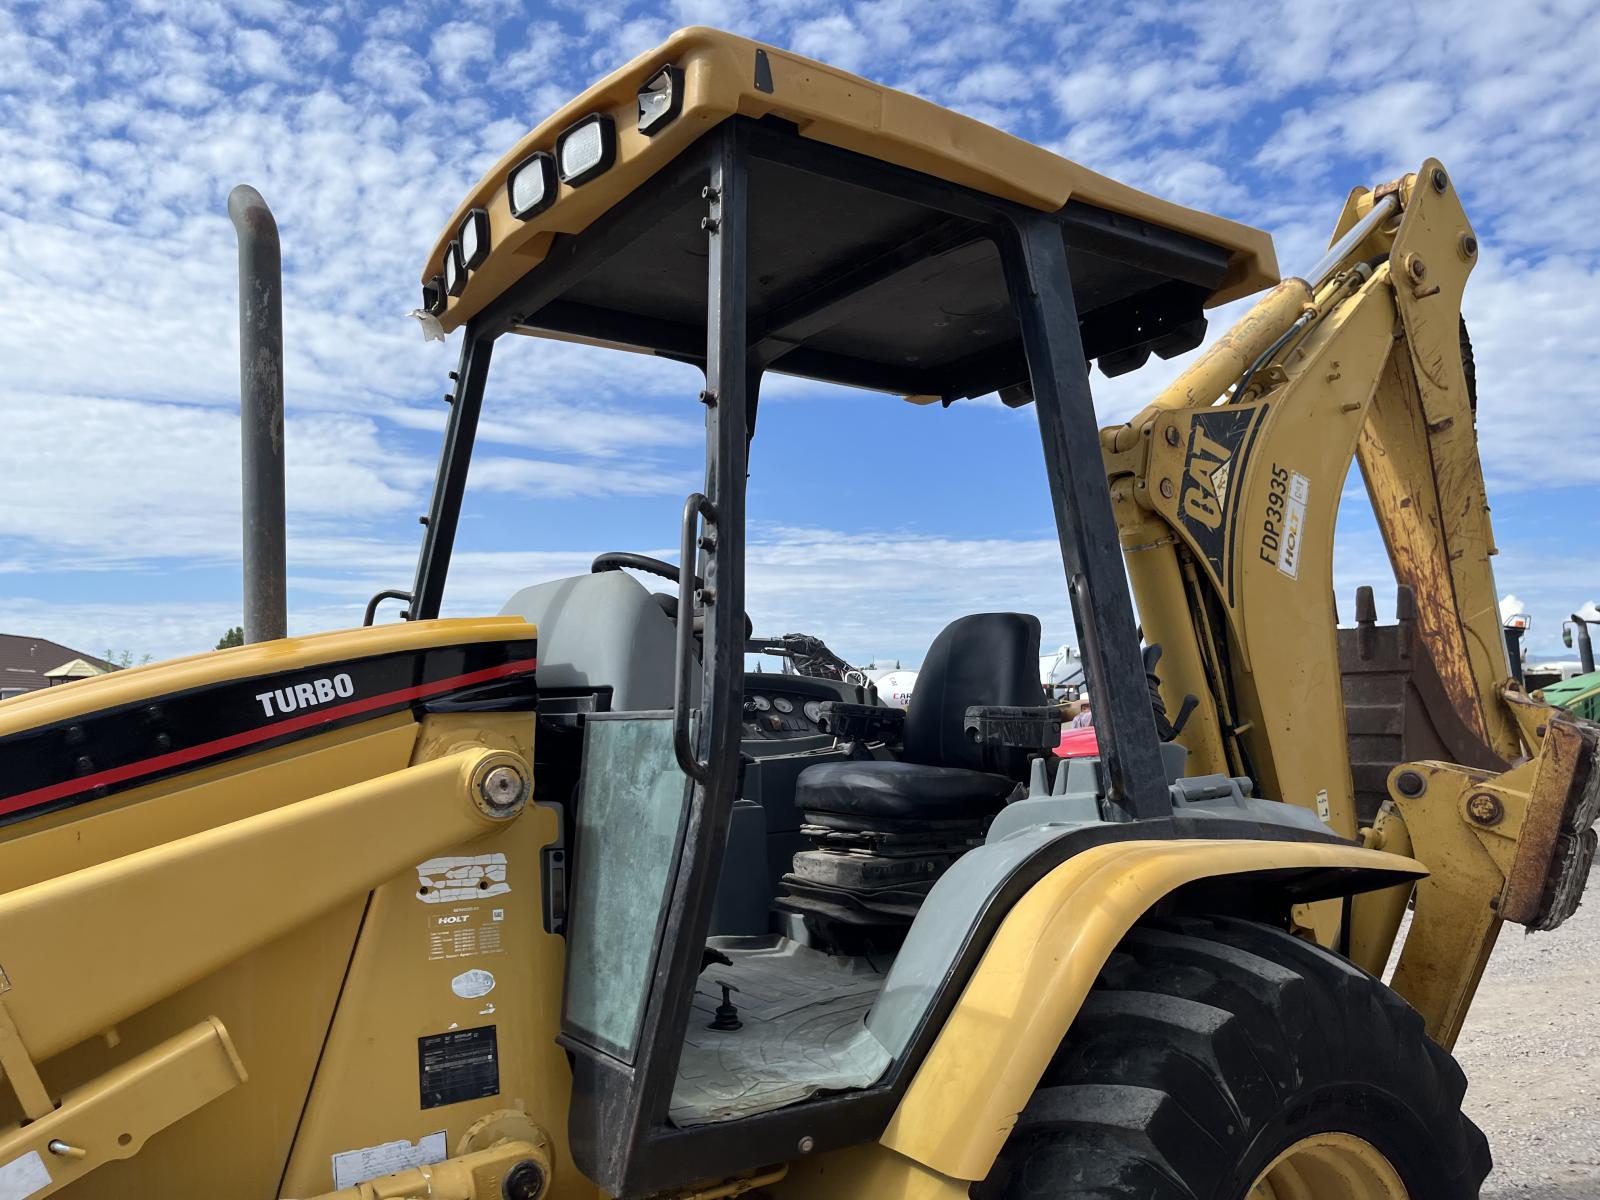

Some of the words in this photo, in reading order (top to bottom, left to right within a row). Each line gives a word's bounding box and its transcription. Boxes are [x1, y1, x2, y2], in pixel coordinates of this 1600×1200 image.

[1184, 423, 1232, 529] CAT
[1260, 463, 1289, 566] FDP3935
[1284, 509, 1301, 567] HOLT
[255, 673, 354, 717] TURBO
[438, 915, 470, 925] HOLT
